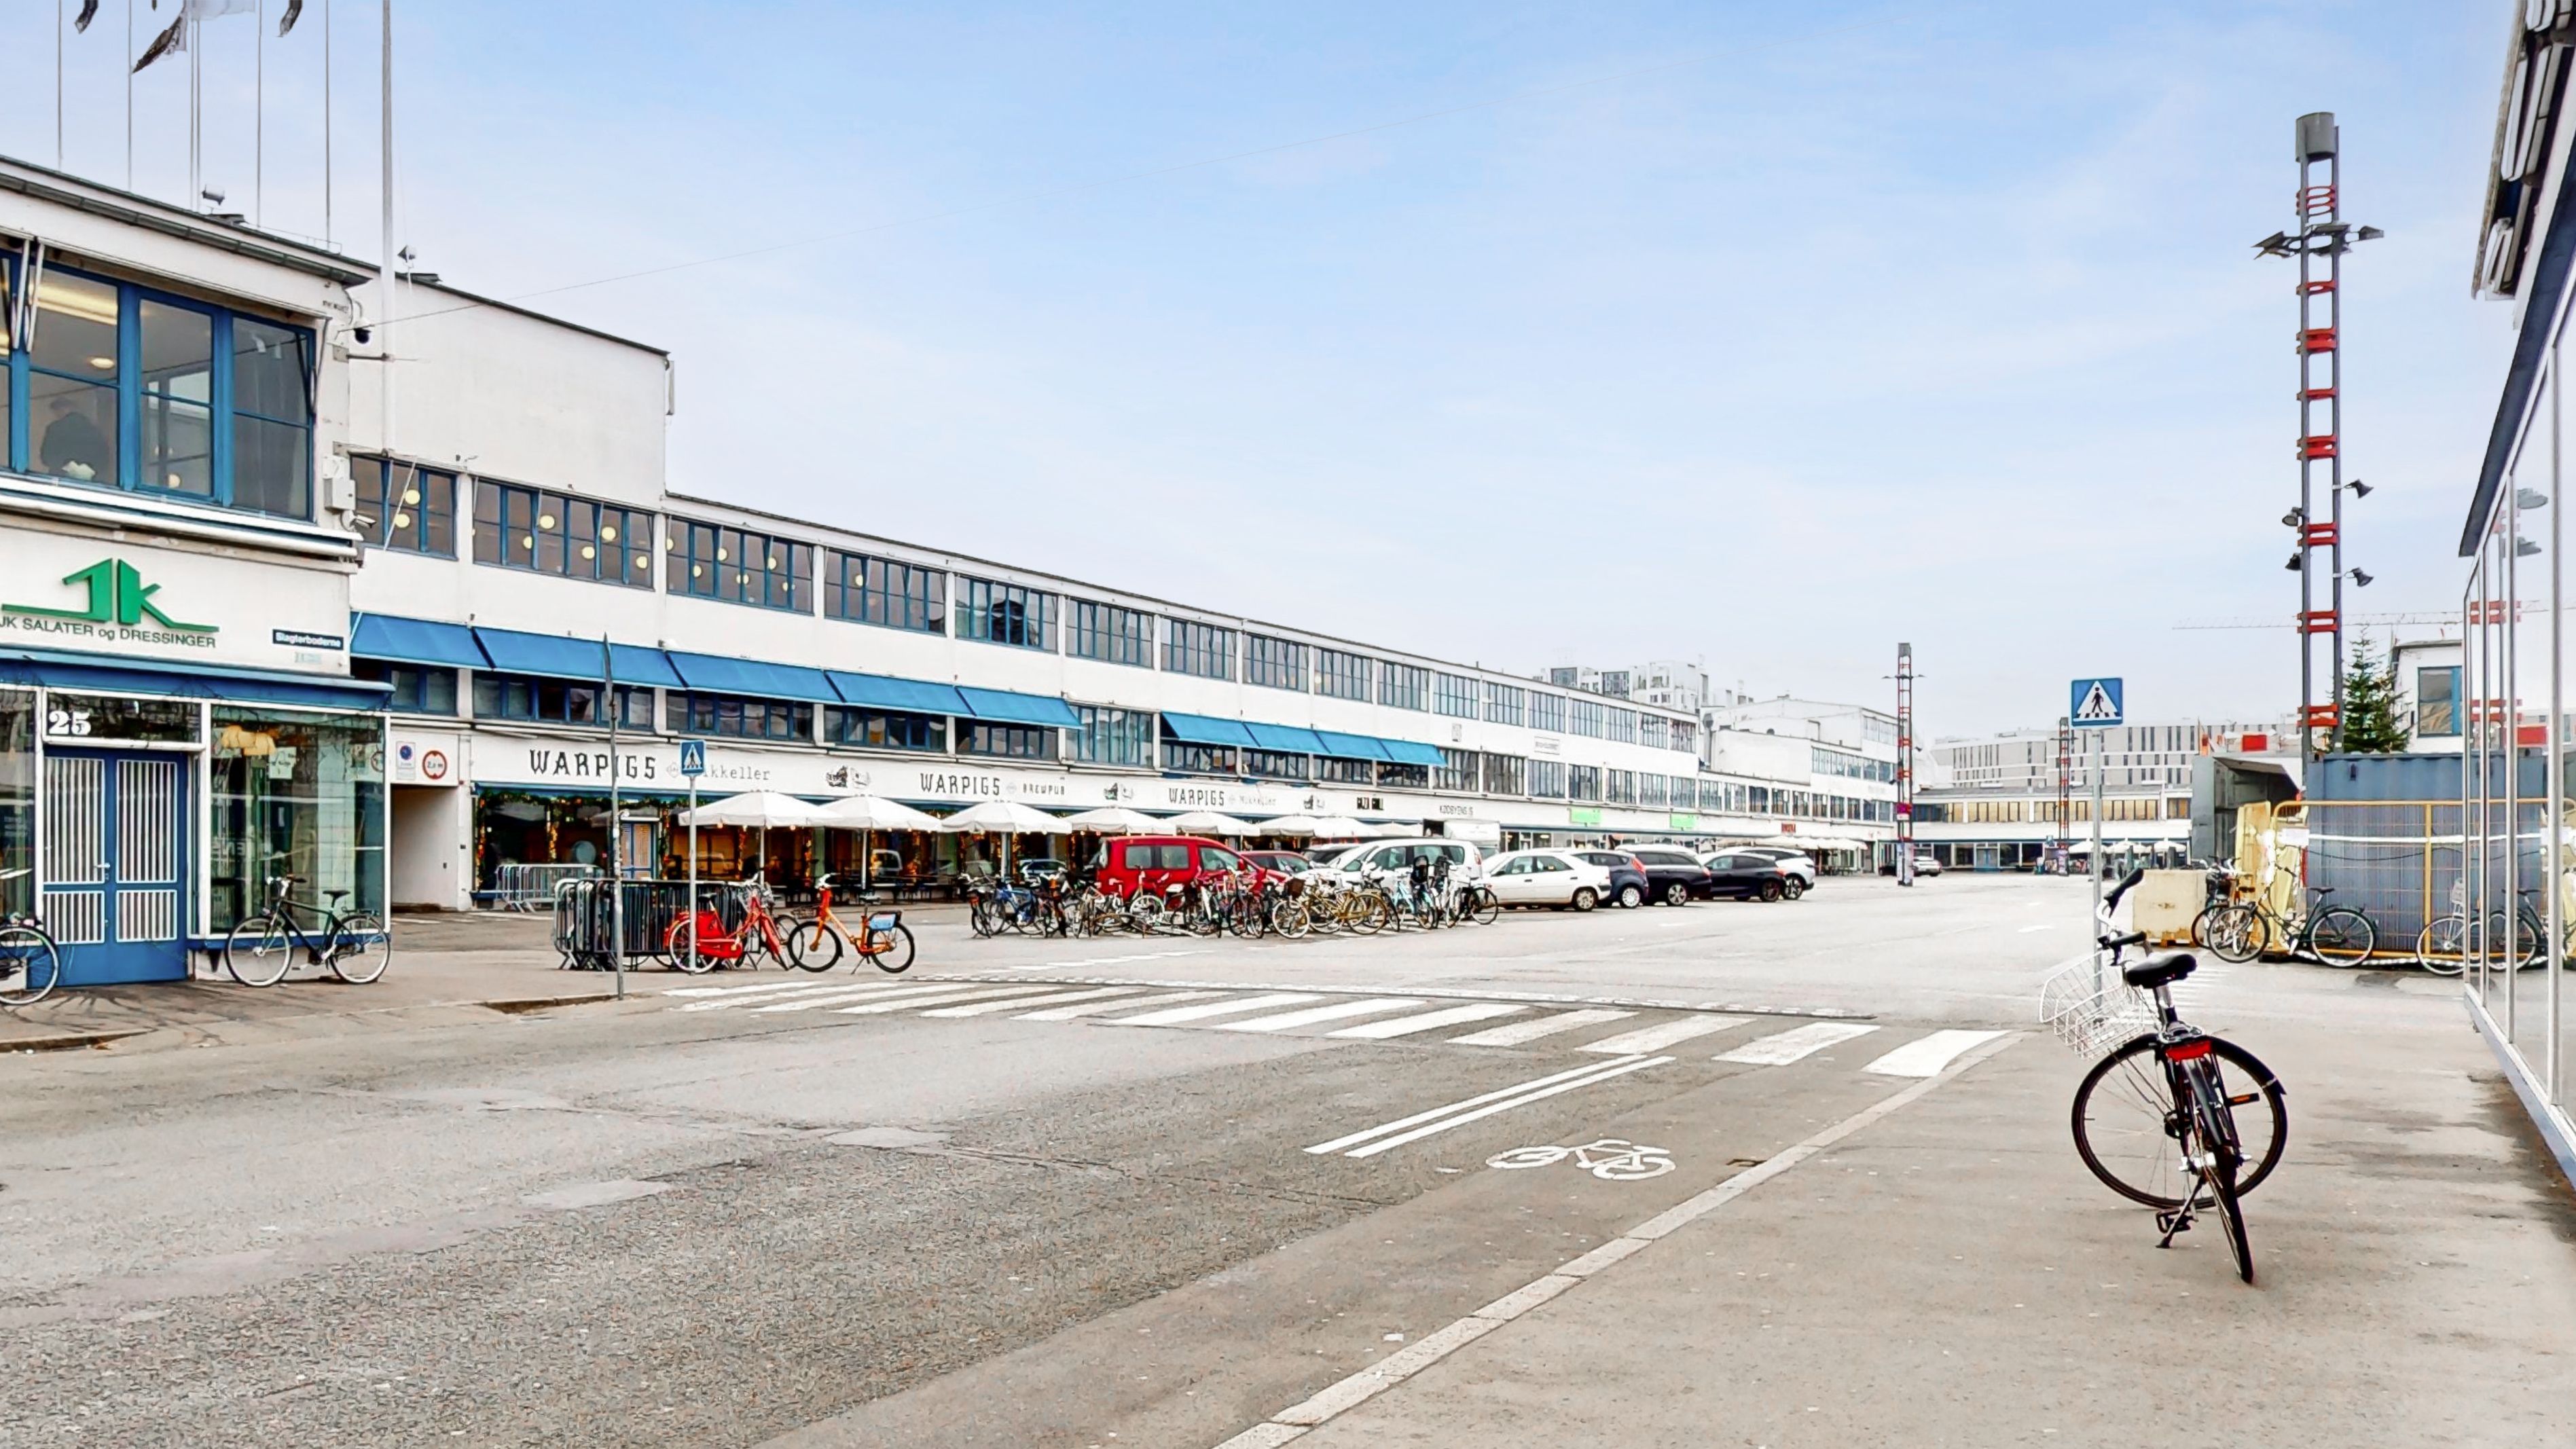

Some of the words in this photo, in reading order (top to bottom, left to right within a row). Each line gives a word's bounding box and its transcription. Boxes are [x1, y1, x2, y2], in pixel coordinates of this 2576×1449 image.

[22, 617, 94, 637] SALATER
[98, 629, 115, 641] og
[120, 628, 216, 648] DRESSINGER
[48, 710, 92, 736] 25
[920, 773, 1000, 796] WARPIGS
[1023, 783, 1066, 796] BREWPUB
[1168, 788, 1225, 807] WARPIGS
